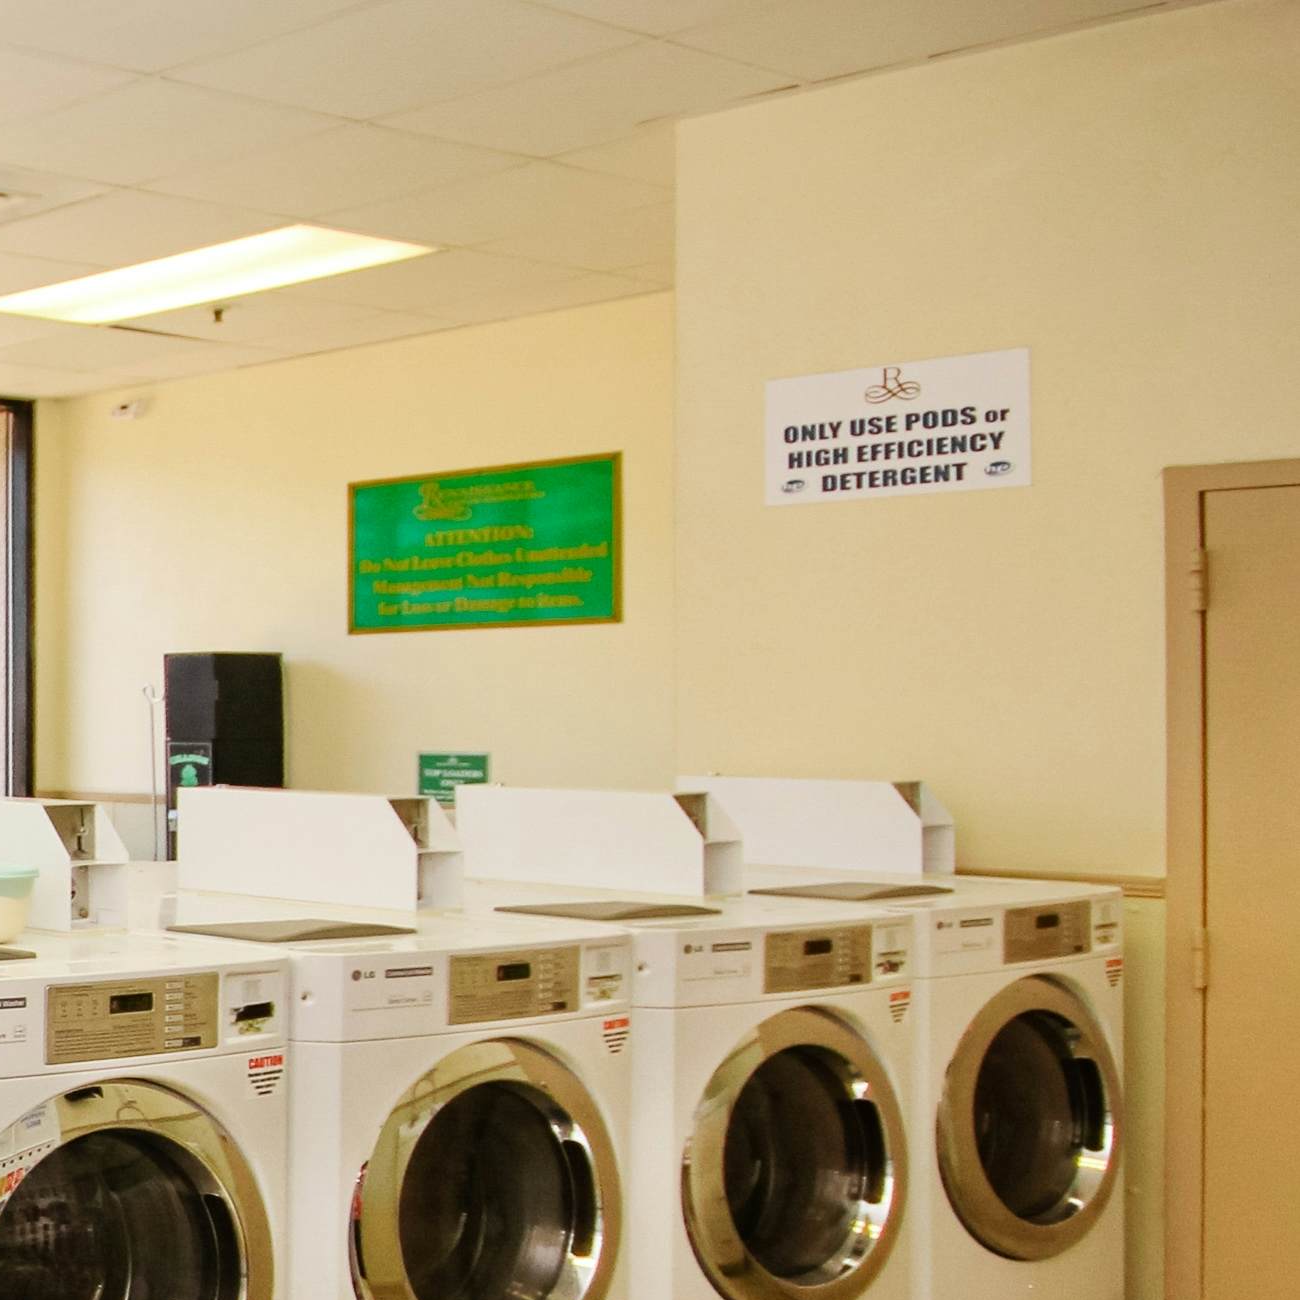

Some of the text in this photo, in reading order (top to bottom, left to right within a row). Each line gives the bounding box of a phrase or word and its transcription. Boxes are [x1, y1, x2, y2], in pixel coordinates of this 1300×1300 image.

[783, 406, 1010, 444] ONLY USE PODS or
[788, 431, 1005, 469] HIGH EFFICIENCY
[822, 463, 968, 493] DETERGENT
